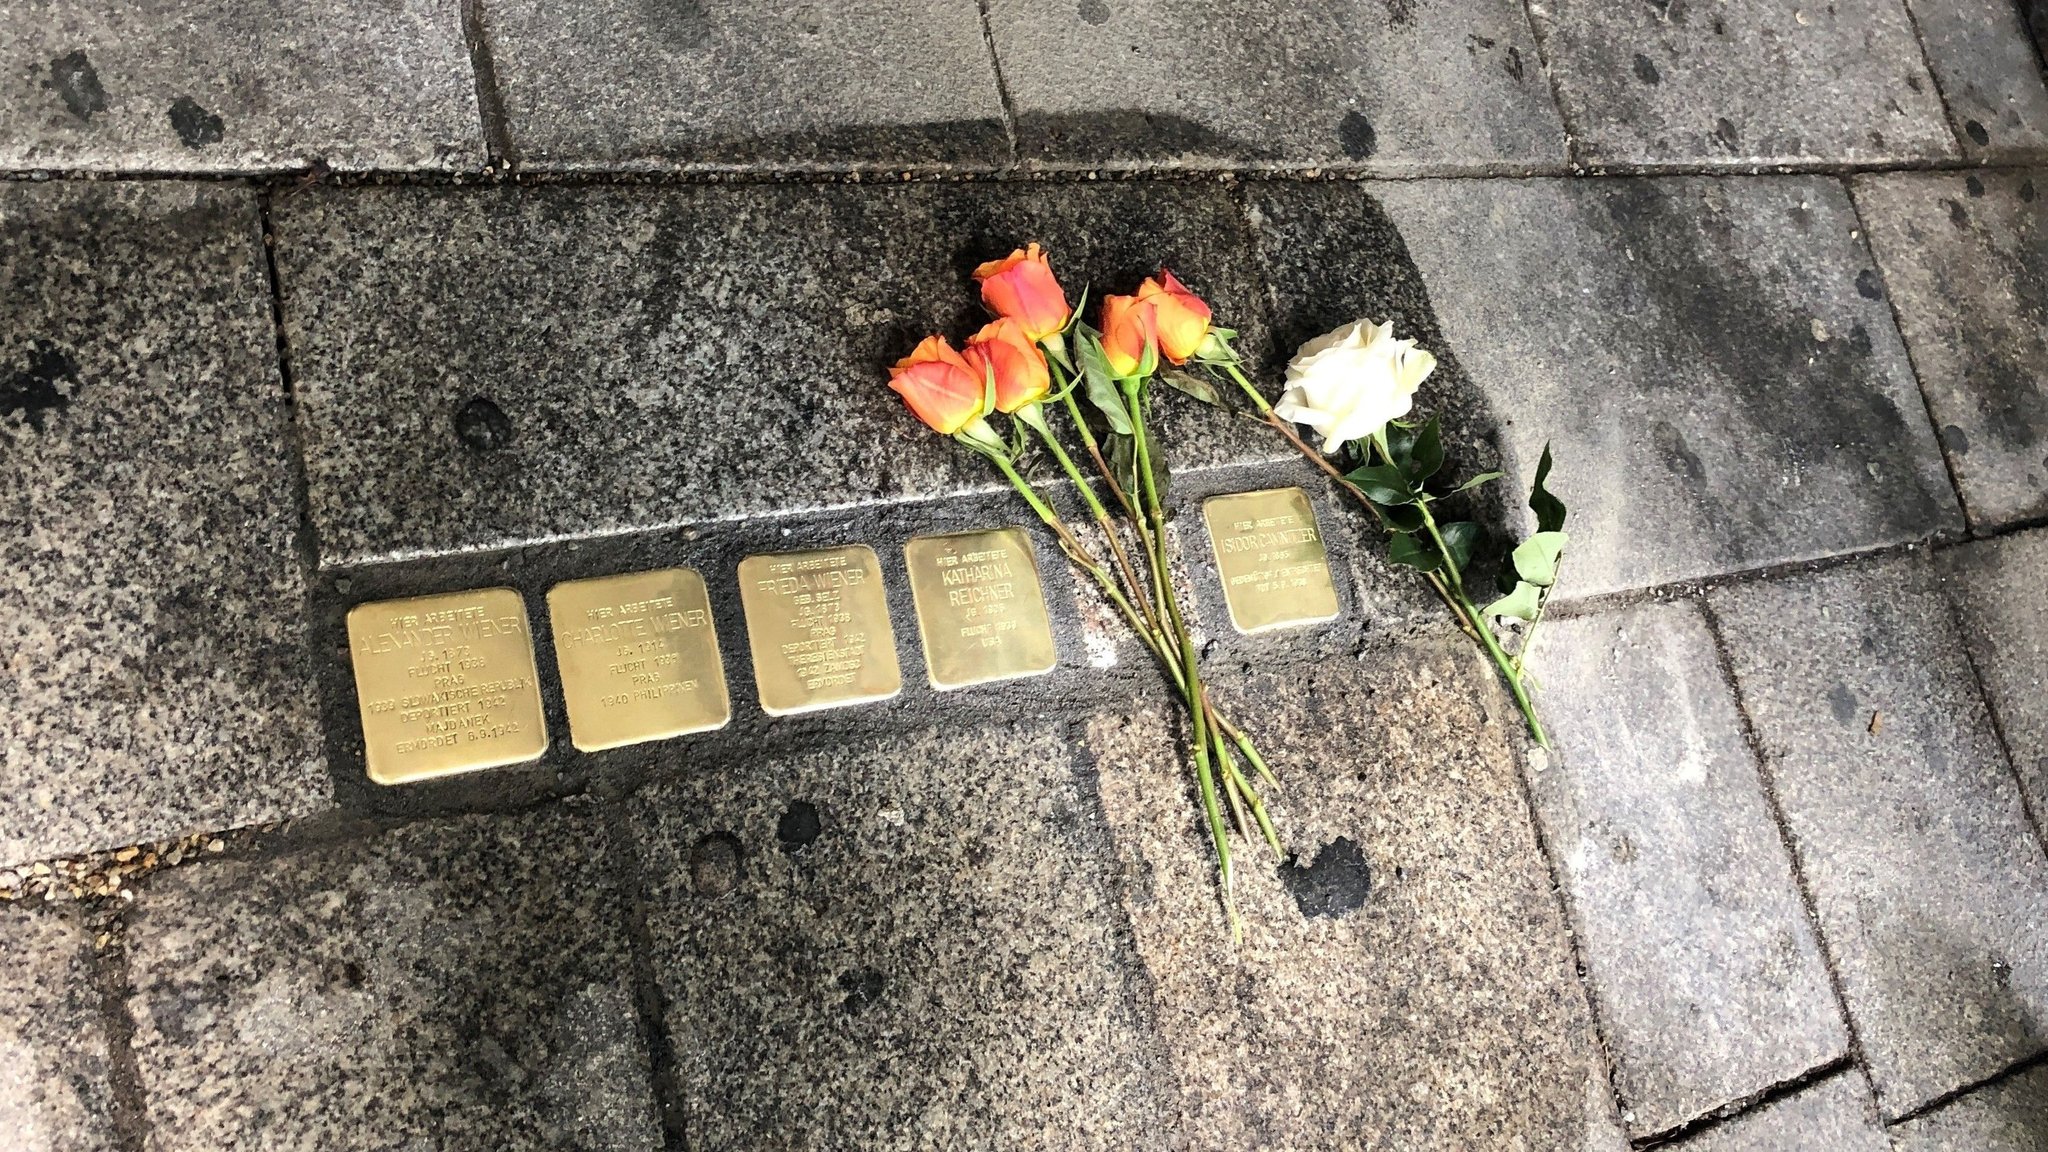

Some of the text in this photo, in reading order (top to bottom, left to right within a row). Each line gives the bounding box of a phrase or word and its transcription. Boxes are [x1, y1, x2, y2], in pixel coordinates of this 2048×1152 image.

[1234, 516, 1294, 529] HIER ARBEITETE
[1221, 535, 1258, 552] ISIDOR
[770, 557, 846, 573] HIER ARBEITETE
[937, 550, 1007, 566] HIER ARBEITETE
[759, 569, 865, 596] FRIEDA WIENER
[942, 562, 1012, 585] KATHARINA
[950, 583, 1014, 606] REICHNER
[391, 607, 484, 627] HIER ARBEITETE
[587, 597, 673, 620] HIER ARBEITETE
[561, 609, 706, 648] CHARLOTTE WIENER
[791, 617, 824, 628] FLUCHT
[358, 617, 521, 654] ALEXANDER WIENER
[811, 627, 836, 637] PRAG
[782, 638, 837, 653] DEPORTIERT
[408, 662, 451, 677] FLUCHT
[609, 659, 646, 674] FLUCHT
[435, 675, 465, 687] PRAG
[633, 672, 660, 685] PRAG
[808, 673, 857, 688] ERMORDET
[401, 685, 479, 708] SLOWAKISCHE
[481, 676, 532, 694] REPUBLIK
[601, 679, 699, 707] 1940 PHILIPPINEN
[400, 695, 506, 723] DEPORTIERT 1942
[426, 713, 489, 734] MAJDANEK
[397, 733, 458, 754] ERMORDET
